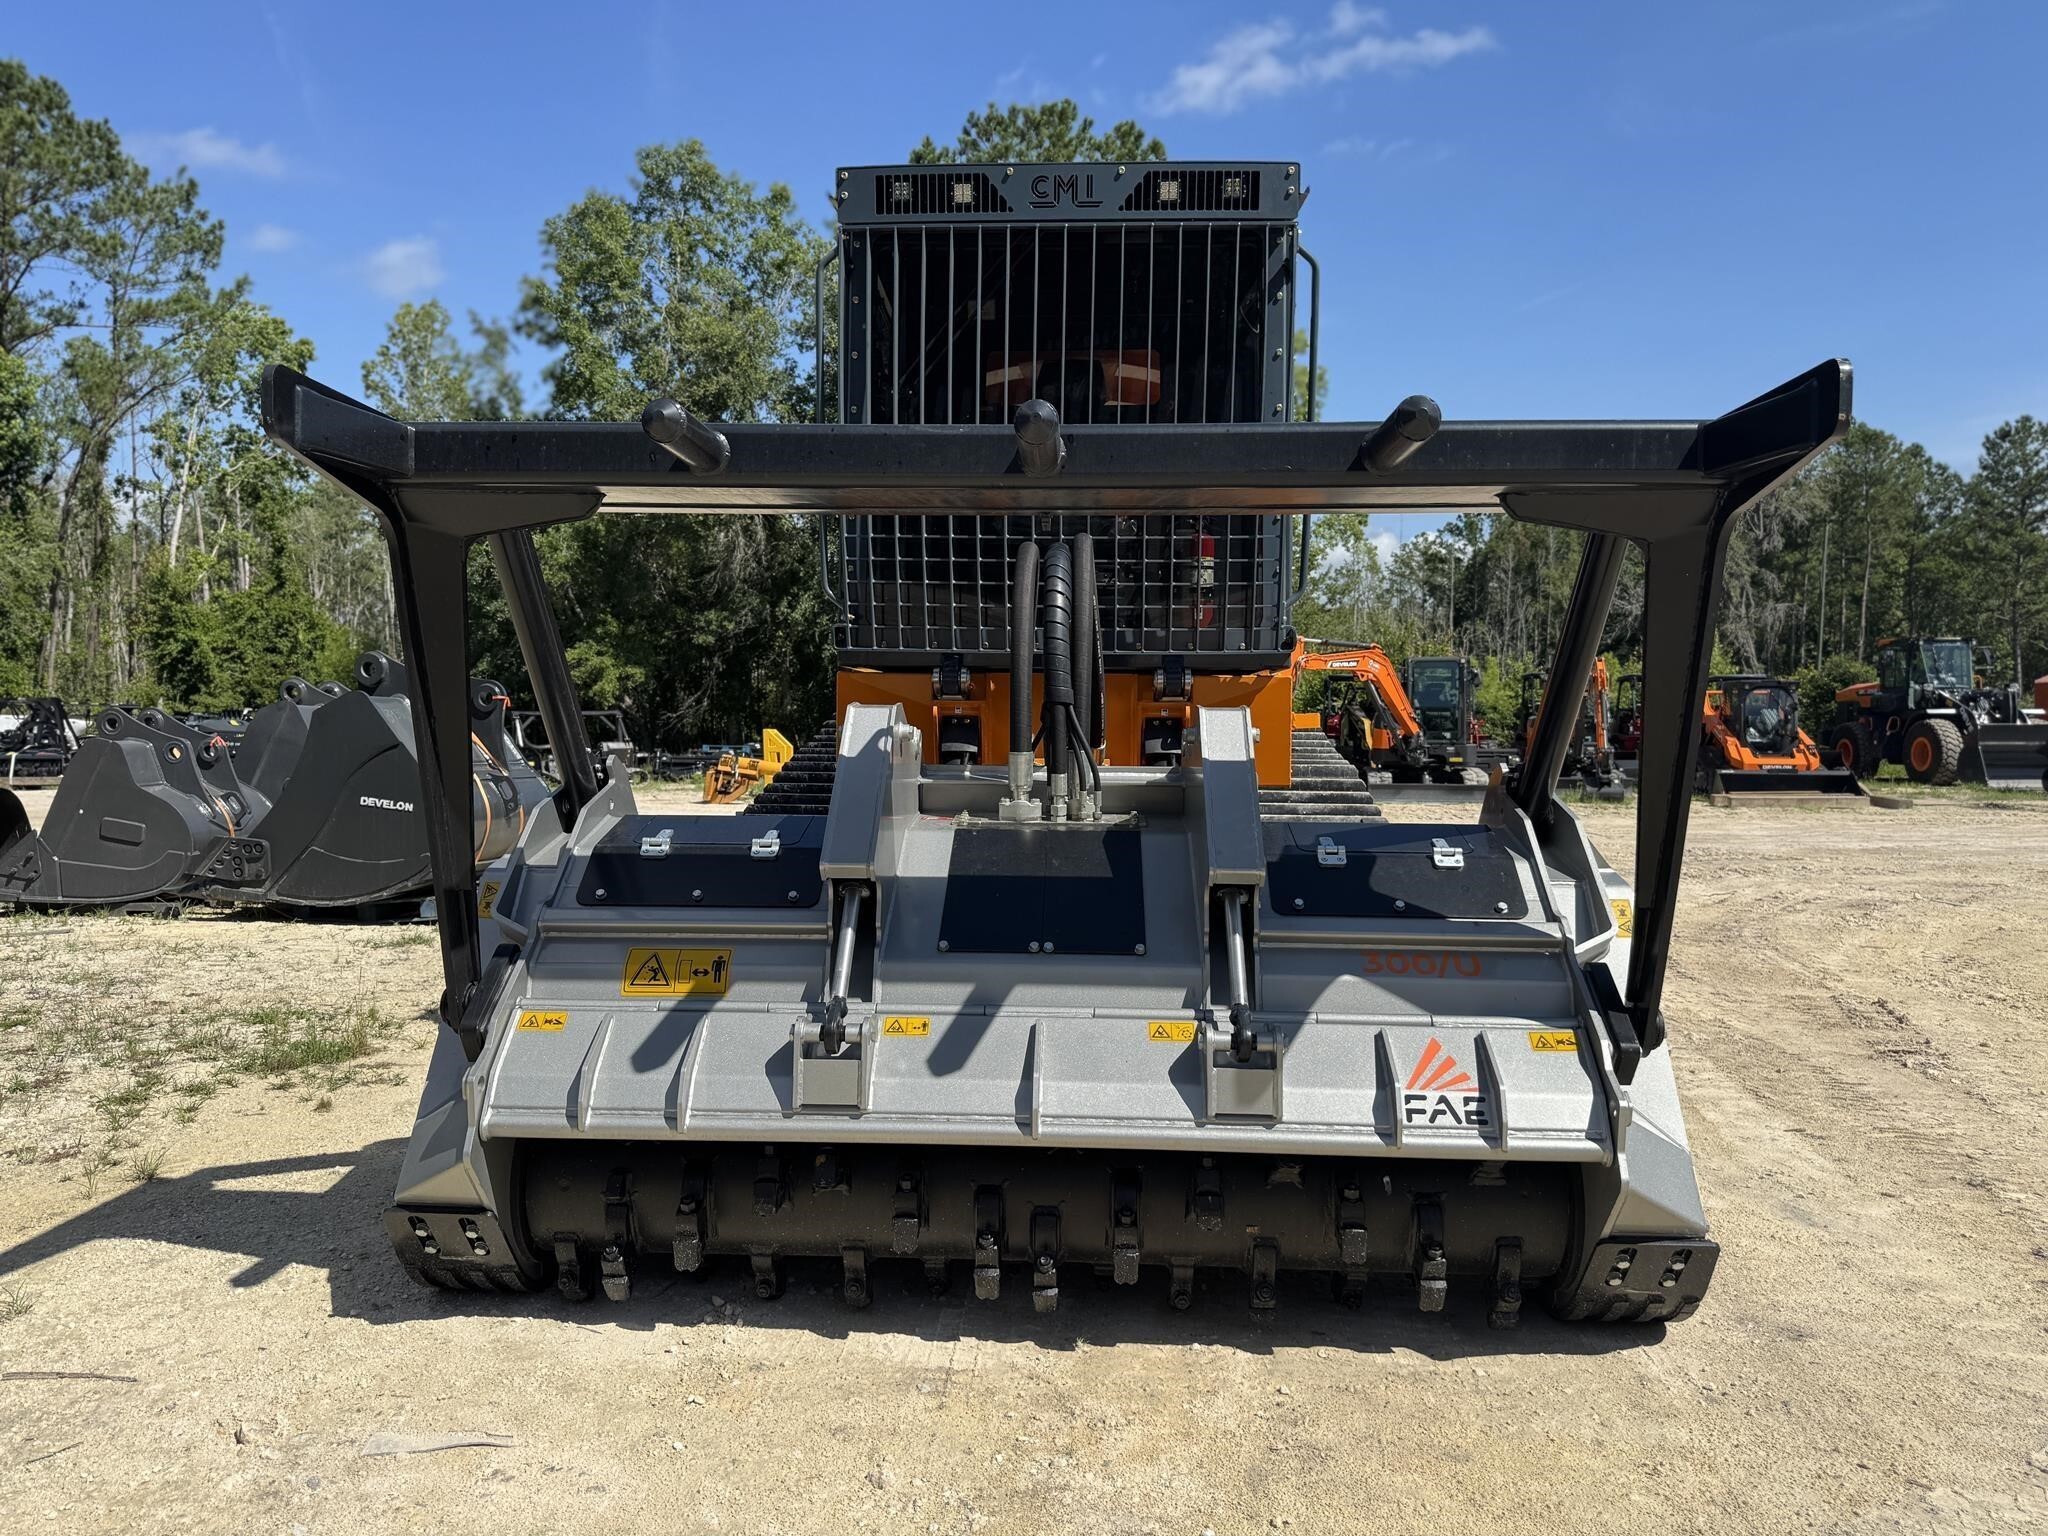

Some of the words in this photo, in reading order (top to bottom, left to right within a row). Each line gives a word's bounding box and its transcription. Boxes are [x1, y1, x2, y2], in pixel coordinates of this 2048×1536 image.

[1029, 174, 1102, 208] CMI
[360, 796, 414, 812] DEVELON
[1361, 950, 1482, 978] 300/U
[1404, 1094, 1489, 1126] FAE
